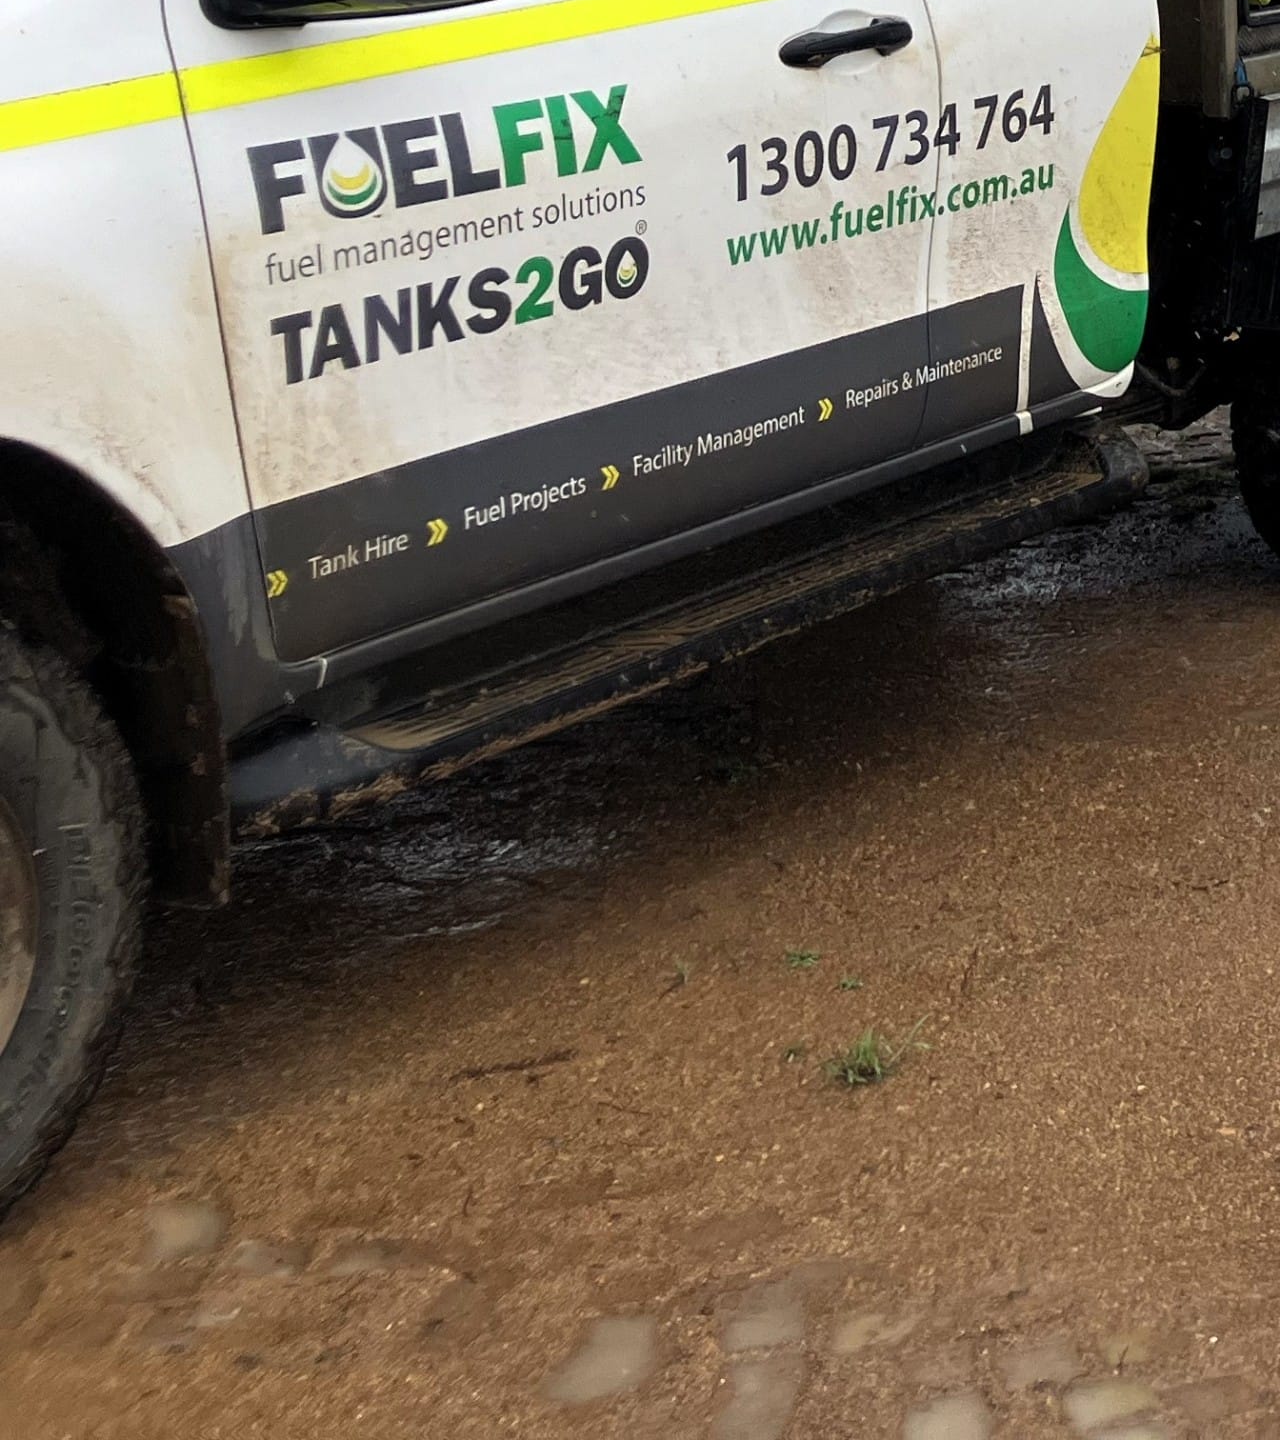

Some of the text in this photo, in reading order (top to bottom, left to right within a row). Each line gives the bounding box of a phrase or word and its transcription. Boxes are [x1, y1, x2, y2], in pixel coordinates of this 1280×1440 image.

[246, 83, 643, 235] FUELFIX
[726, 83, 1055, 202] 1300 734 764
[265, 183, 647, 286] fuel management solutions
[726, 163, 1055, 266] www.fuelfix.com.au
[269, 235, 650, 386] TANKS2GO
[845, 346, 1003, 409] Repairs & Maintenance
[633, 405, 806, 477] Facility Management
[463, 475, 587, 530] Fuel Projects
[307, 532, 409, 579] Tank Hire
